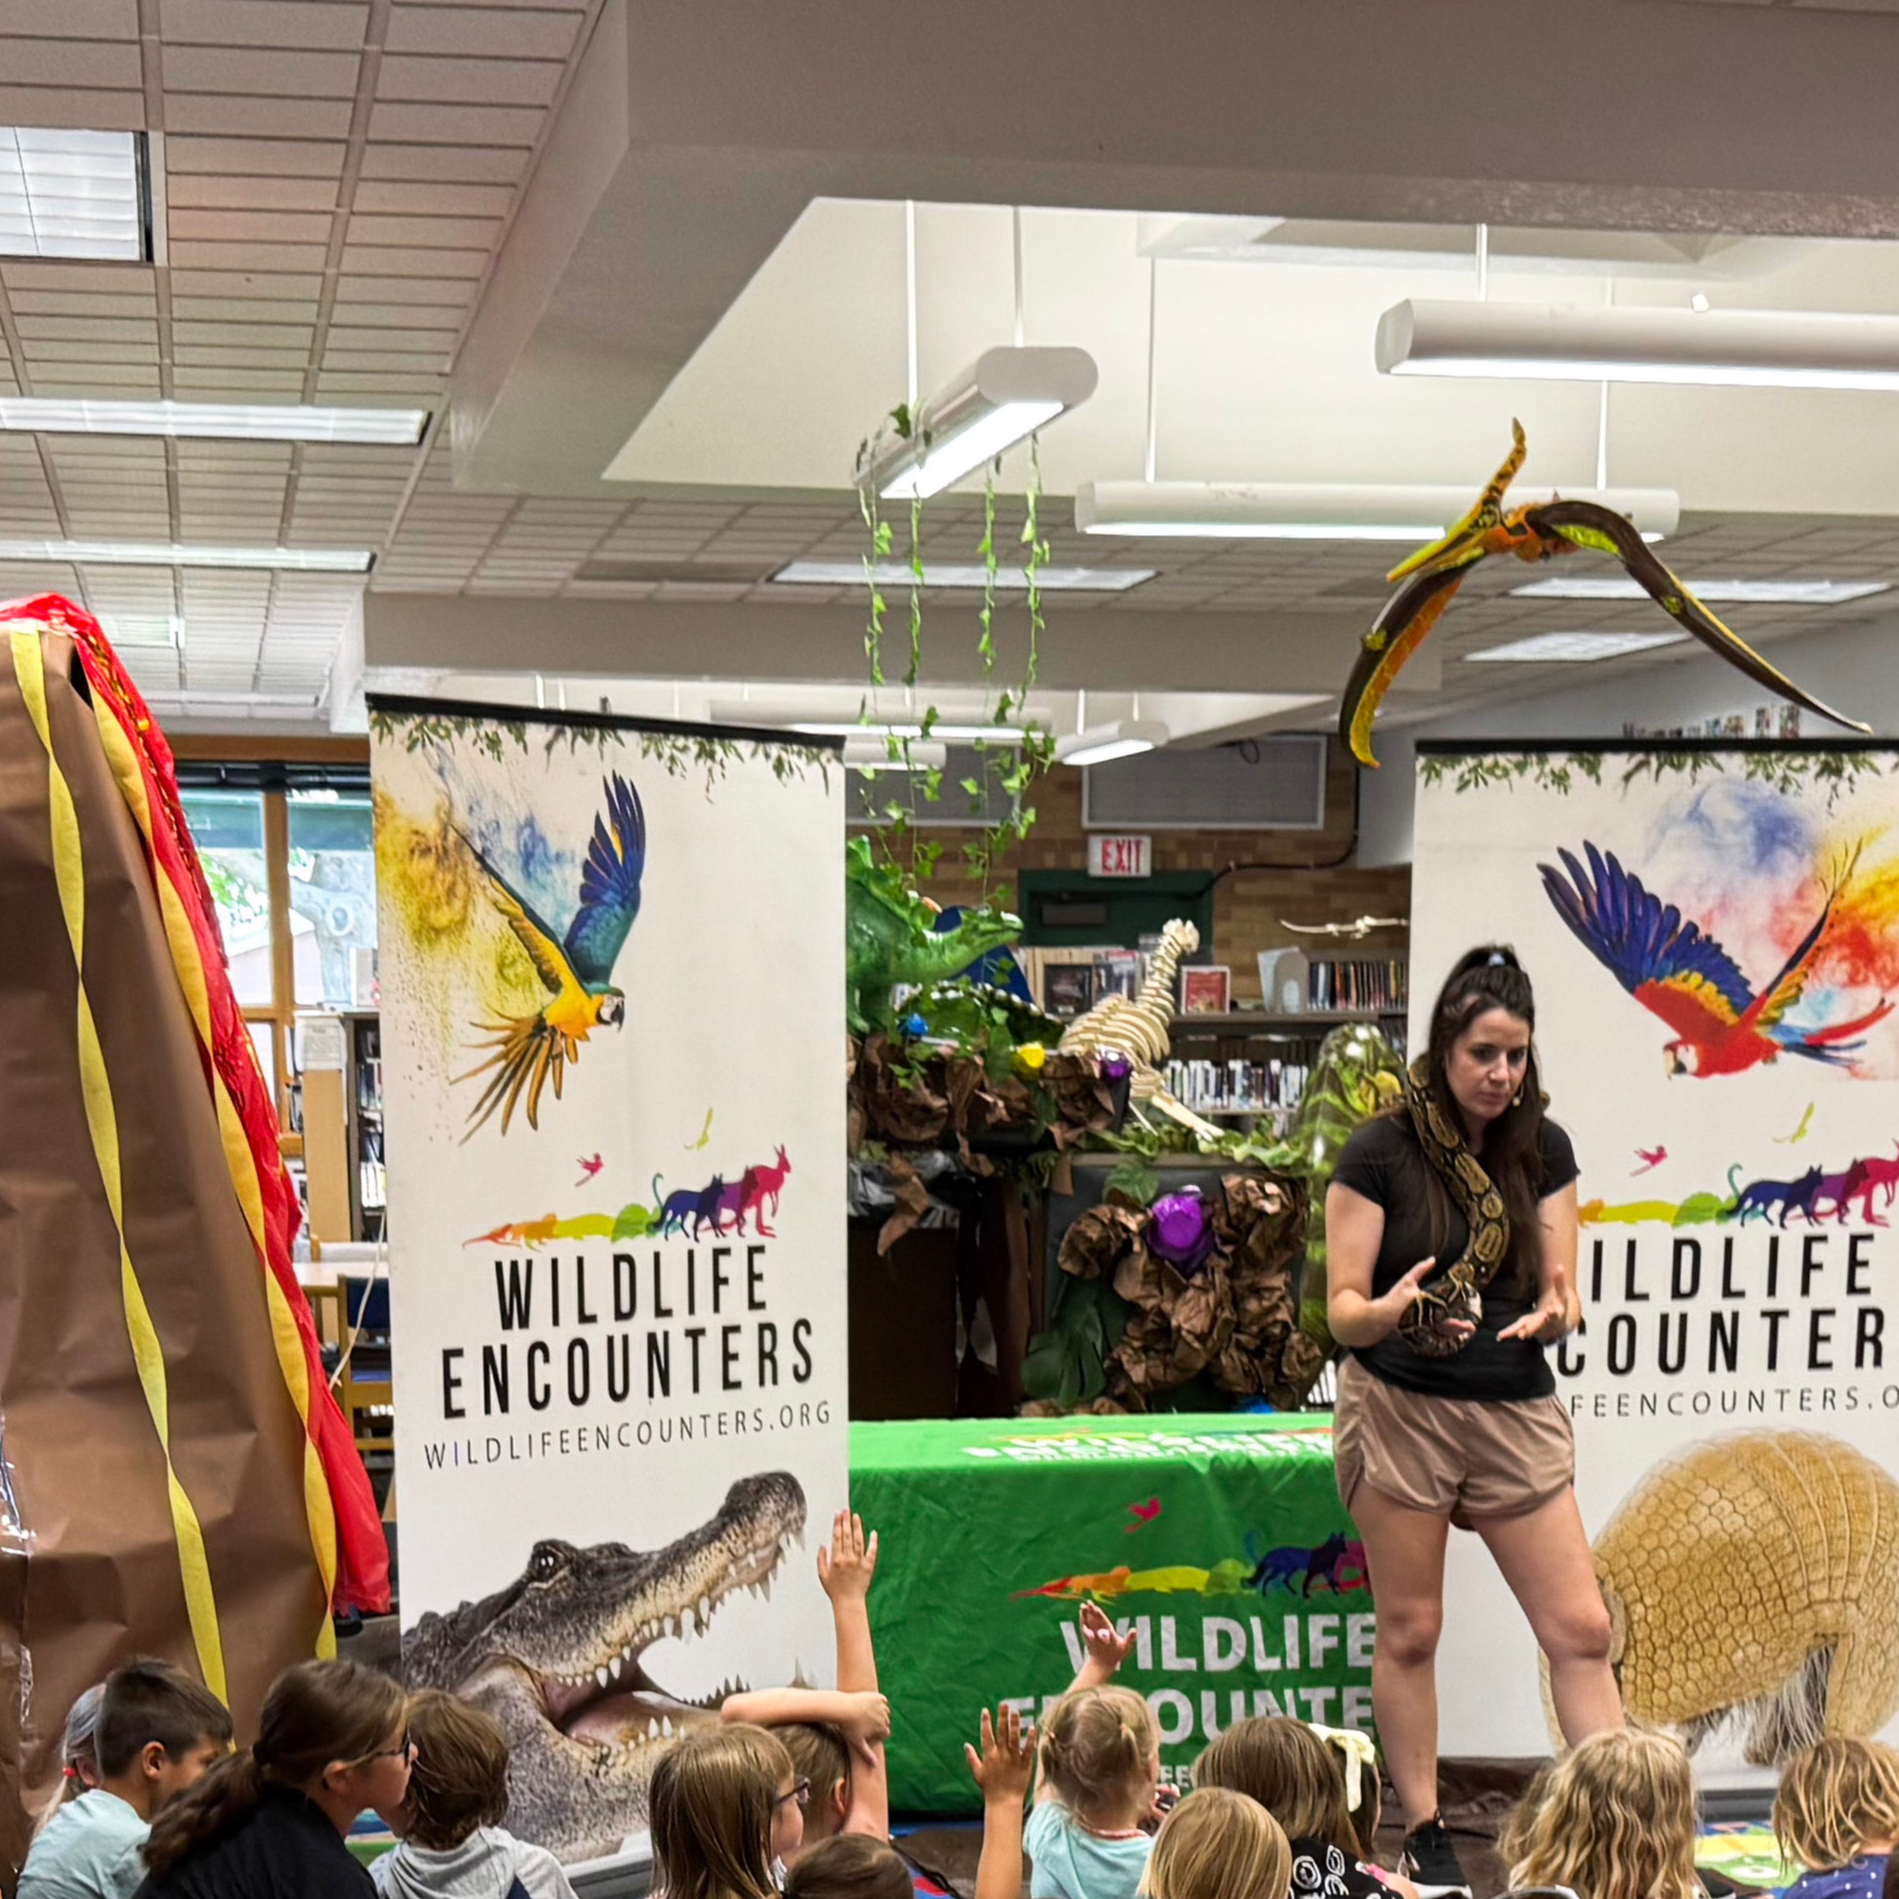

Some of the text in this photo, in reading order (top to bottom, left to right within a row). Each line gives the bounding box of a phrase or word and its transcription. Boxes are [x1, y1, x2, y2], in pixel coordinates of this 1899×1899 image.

[1102, 839, 1142, 875] EXIT
[495, 1244, 766, 1331] WILDLIFE
[1592, 1234, 1875, 1303] ILDLIFE
[442, 1318, 812, 1419] ENCOUNTERS
[424, 1400, 831, 1470] WILDLIFEENCOUNTERS.ORG
[1060, 1614, 1375, 1673] WILDLIFE
[1001, 1687, 1372, 1750] EOUNTE
